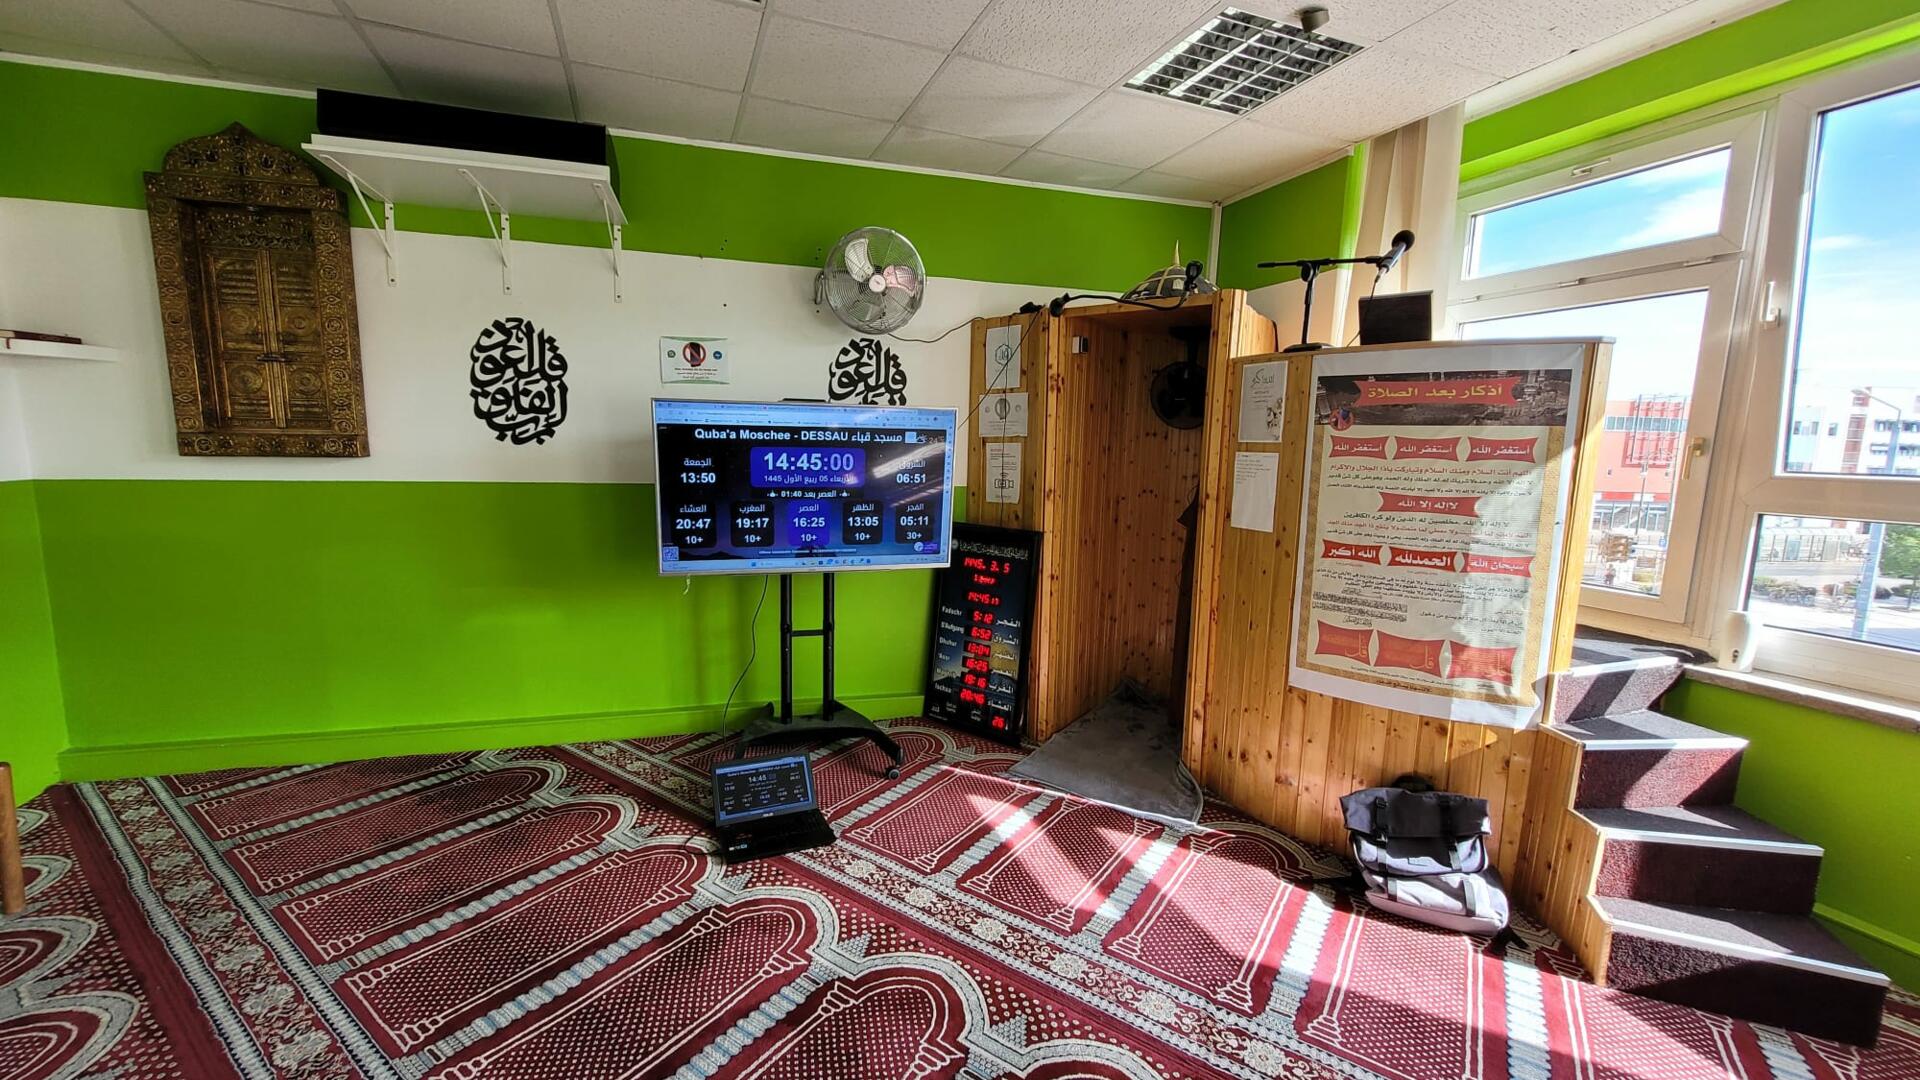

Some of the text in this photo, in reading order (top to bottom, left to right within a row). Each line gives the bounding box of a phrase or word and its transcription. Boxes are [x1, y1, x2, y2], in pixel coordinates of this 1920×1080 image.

[1368, 387, 1418, 398] الصلاة
[1425, 387, 1456, 399] بعد
[695, 428, 737, 440] Quba'a
[739, 429, 791, 441] Moschee
[801, 430, 849, 442] DESSAU
[851, 431, 871, 443] قباء
[874, 432, 903, 443] مسجد
[683, 457, 712, 468] الجمعة
[764, 452, 854, 471] 14:45:00
[680, 472, 716, 483] 13:50
[896, 473, 926, 484] 06:51
[780, 490, 802, 498] 01:40
[680, 504, 707, 513] العشاء
[739, 504, 765, 514] المغرب
[798, 504, 819, 513] العصر
[852, 503, 875, 513] الظهر
[906, 503, 924, 513] الفجر
[675, 518, 711, 530] 20:47
[736, 517, 769, 529] 19:17
[793, 517, 825, 528] 16:25
[847, 516, 879, 527] 13:05
[900, 516, 929, 526] 05:11
[685, 535, 704, 544] 10+
[744, 534, 762, 543] 10+
[801, 533, 817, 542] 10+
[855, 532, 872, 541] 10+
[906, 531, 922, 540] 30+
[1358, 549, 1376, 558] الله
